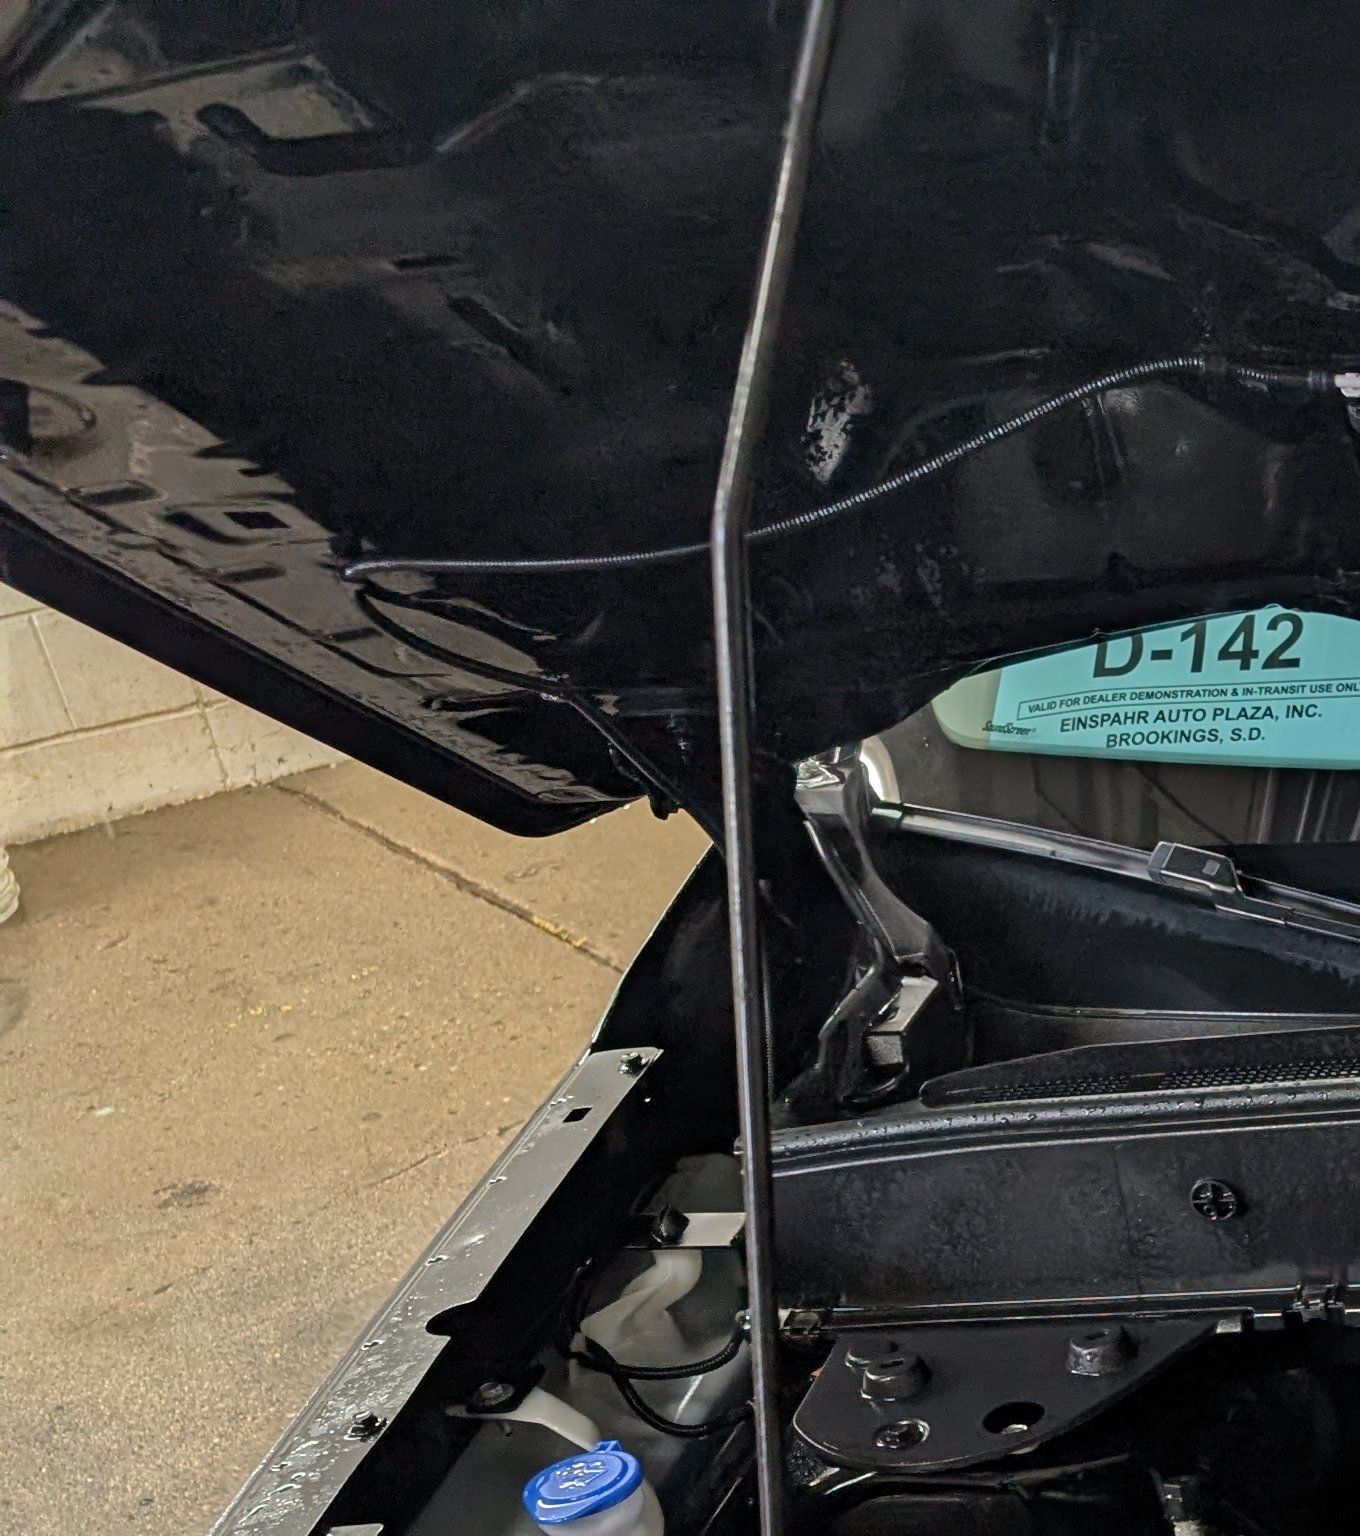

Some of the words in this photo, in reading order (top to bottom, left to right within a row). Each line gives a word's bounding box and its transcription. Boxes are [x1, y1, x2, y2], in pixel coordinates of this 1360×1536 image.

[1093, 613, 1303, 678] D-142
[1028, 700, 1057, 713] VALID
[1059, 697, 1081, 709] FOR
[1083, 692, 1127, 706] DEALER
[1130, 687, 1229, 702] DEMONSTRATION
[1231, 687, 1239, 697] &
[1242, 685, 1306, 697] IN-TRANSIT
[1309, 683, 1333, 694] USE
[1060, 710, 1150, 733] EINSPAHR
[1153, 707, 1206, 726] AUTO
[1212, 705, 1279, 722] PLAZA,
[1285, 703, 1323, 719] INC.
[1106, 727, 1223, 748] BROOKINGS,
[1230, 727, 1266, 742] S.D.
